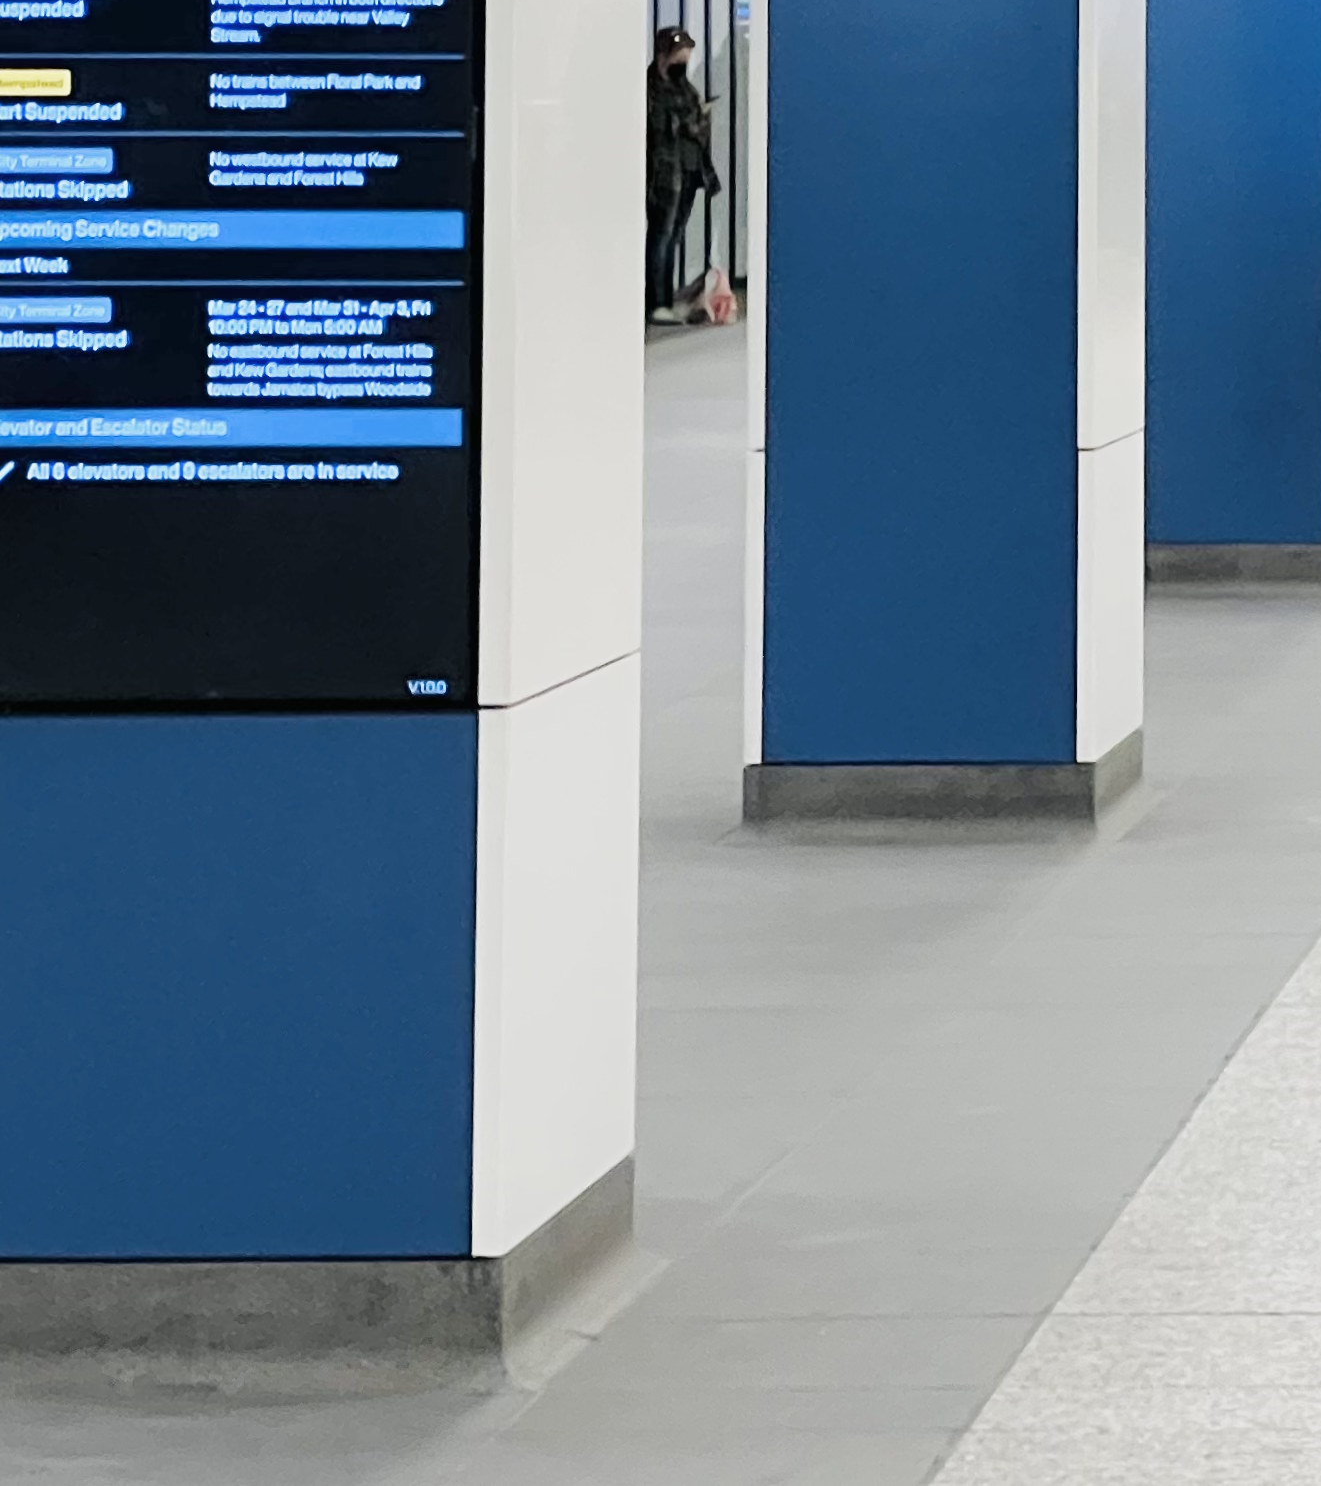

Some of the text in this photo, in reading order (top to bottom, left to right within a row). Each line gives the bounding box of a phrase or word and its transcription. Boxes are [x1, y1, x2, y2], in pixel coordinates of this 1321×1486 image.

[0, 0, 84, 21] uspended
[239, 11, 251, 24] to
[0, 102, 122, 123] art Suspended
[0, 155, 106, 168] ity Terminal Zone
[0, 180, 129, 201] tations Skipped
[0, 220, 220, 241] pcoming Service Changes
[0, 256, 69, 274] ext Week
[19, 304, 71, 317] Terminal
[73, 304, 105, 318] Zone
[0, 329, 127, 350] tations Skipped
[0, 418, 227, 437] evator and Escalator Status
[27, 464, 49, 480] All
[68, 464, 144, 480] elevators
[148, 464, 179, 480] and
[199, 463, 285, 480] escalators
[288, 465, 314, 480] are
[317, 464, 333, 480] in
[336, 464, 399, 480] service
